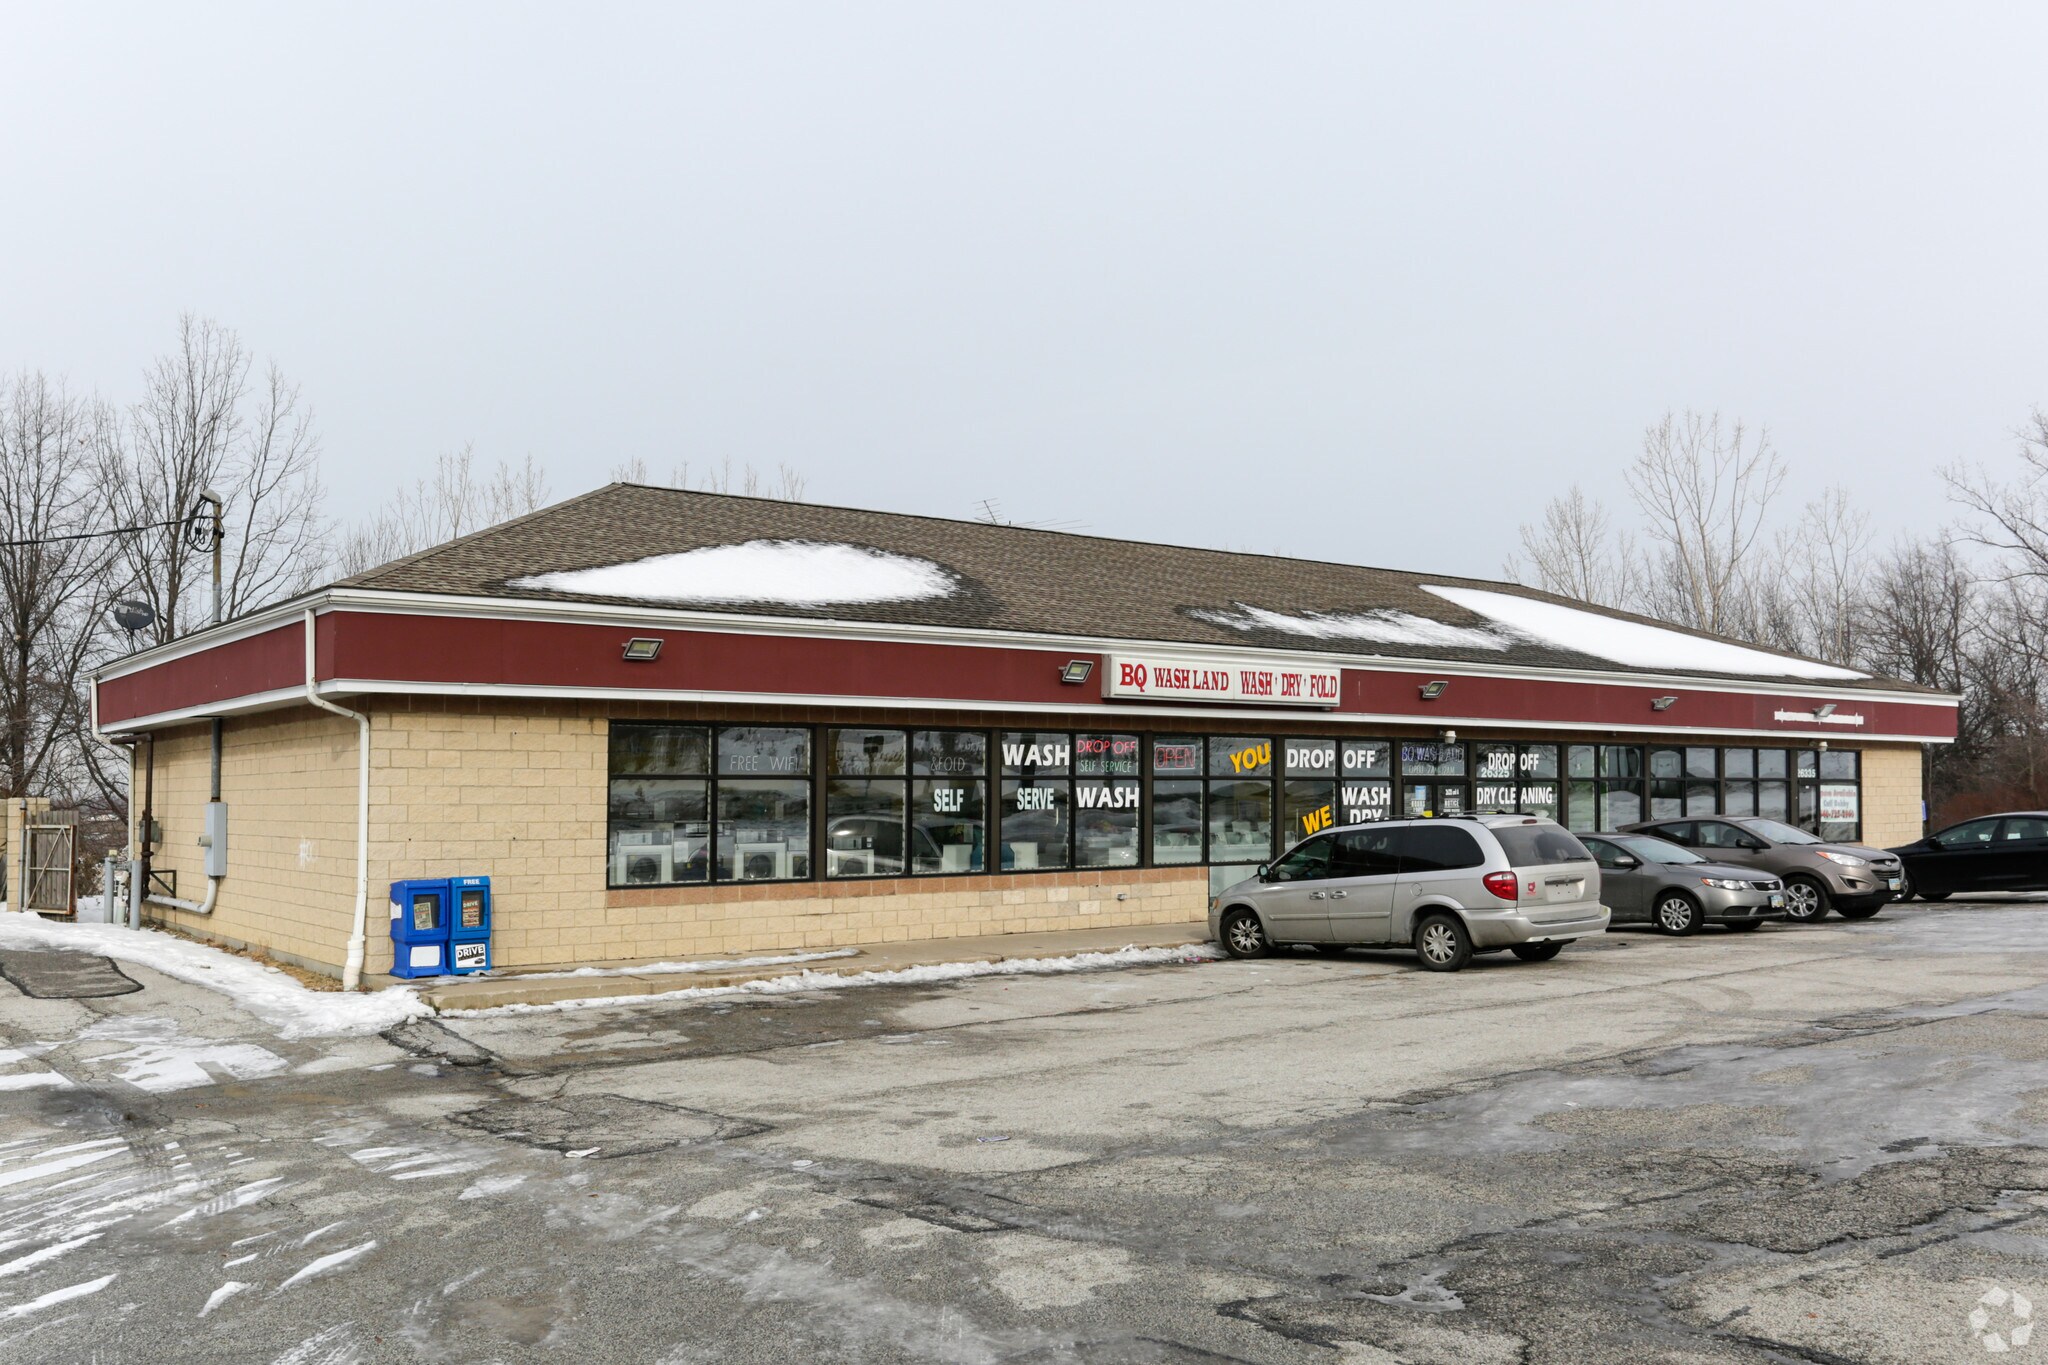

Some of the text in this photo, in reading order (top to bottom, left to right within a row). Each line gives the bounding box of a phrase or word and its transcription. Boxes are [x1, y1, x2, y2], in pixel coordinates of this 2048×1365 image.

[1119, 663, 1148, 692] BQ
[1153, 667, 1191, 689] WASH
[1240, 671, 1273, 696] WASH
[1281, 673, 1303, 697] DRY
[1310, 674, 1338, 698] FOLD
[1002, 744, 1070, 766] WASH
[1077, 740, 1136, 754] DROP OFF
[730, 755, 798, 771] FREE WIFI
[1080, 760, 1132, 773] SELF SERVICE
[1155, 747, 1195, 768] OPEN
[1229, 742, 1376, 773] YOU DROP OFF
[1488, 752, 1539, 771] DROP OFF
[1481, 767, 1510, 778] 26325
[933, 787, 1055, 813] SELF SERVE
[1076, 787, 1140, 808] WASH
[1341, 786, 1391, 806] WASH
[1476, 787, 1497, 804] DRY
[1498, 787, 1553, 804] CLEANING
[1302, 805, 1333, 835] WE
[1349, 808, 1383, 823] DRY
[457, 945, 484, 958] DRIVE
